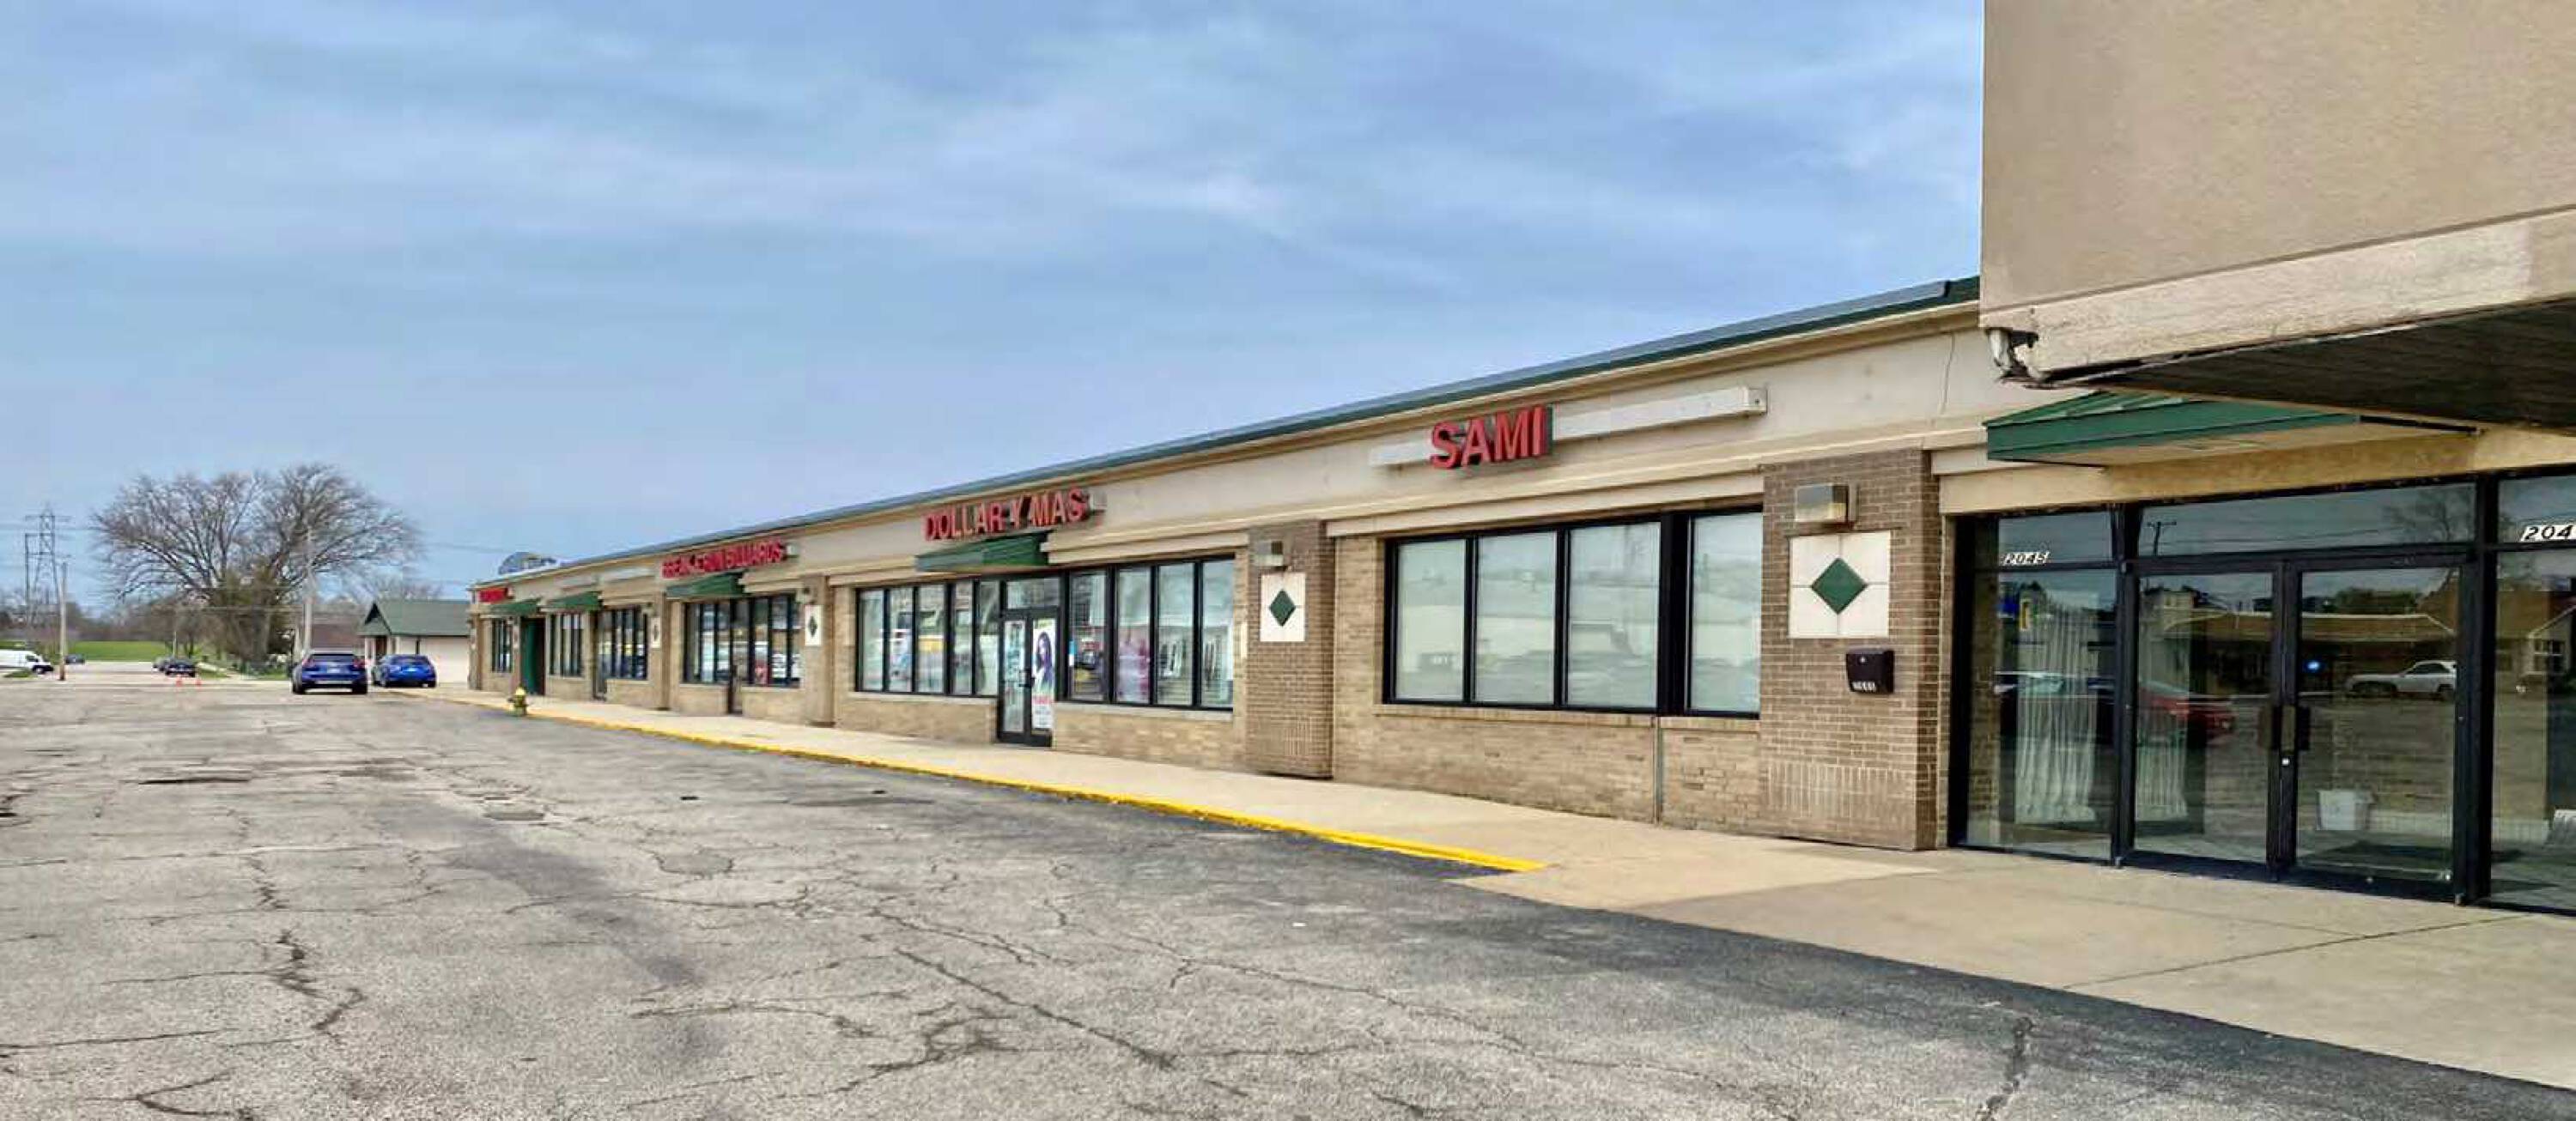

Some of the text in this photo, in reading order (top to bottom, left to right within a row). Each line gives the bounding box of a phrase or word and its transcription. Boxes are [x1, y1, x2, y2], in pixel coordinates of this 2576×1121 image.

[1431, 406, 1549, 469] SAMI
[924, 501, 1005, 541] DOLLAR
[1030, 485, 1088, 528] MAS
